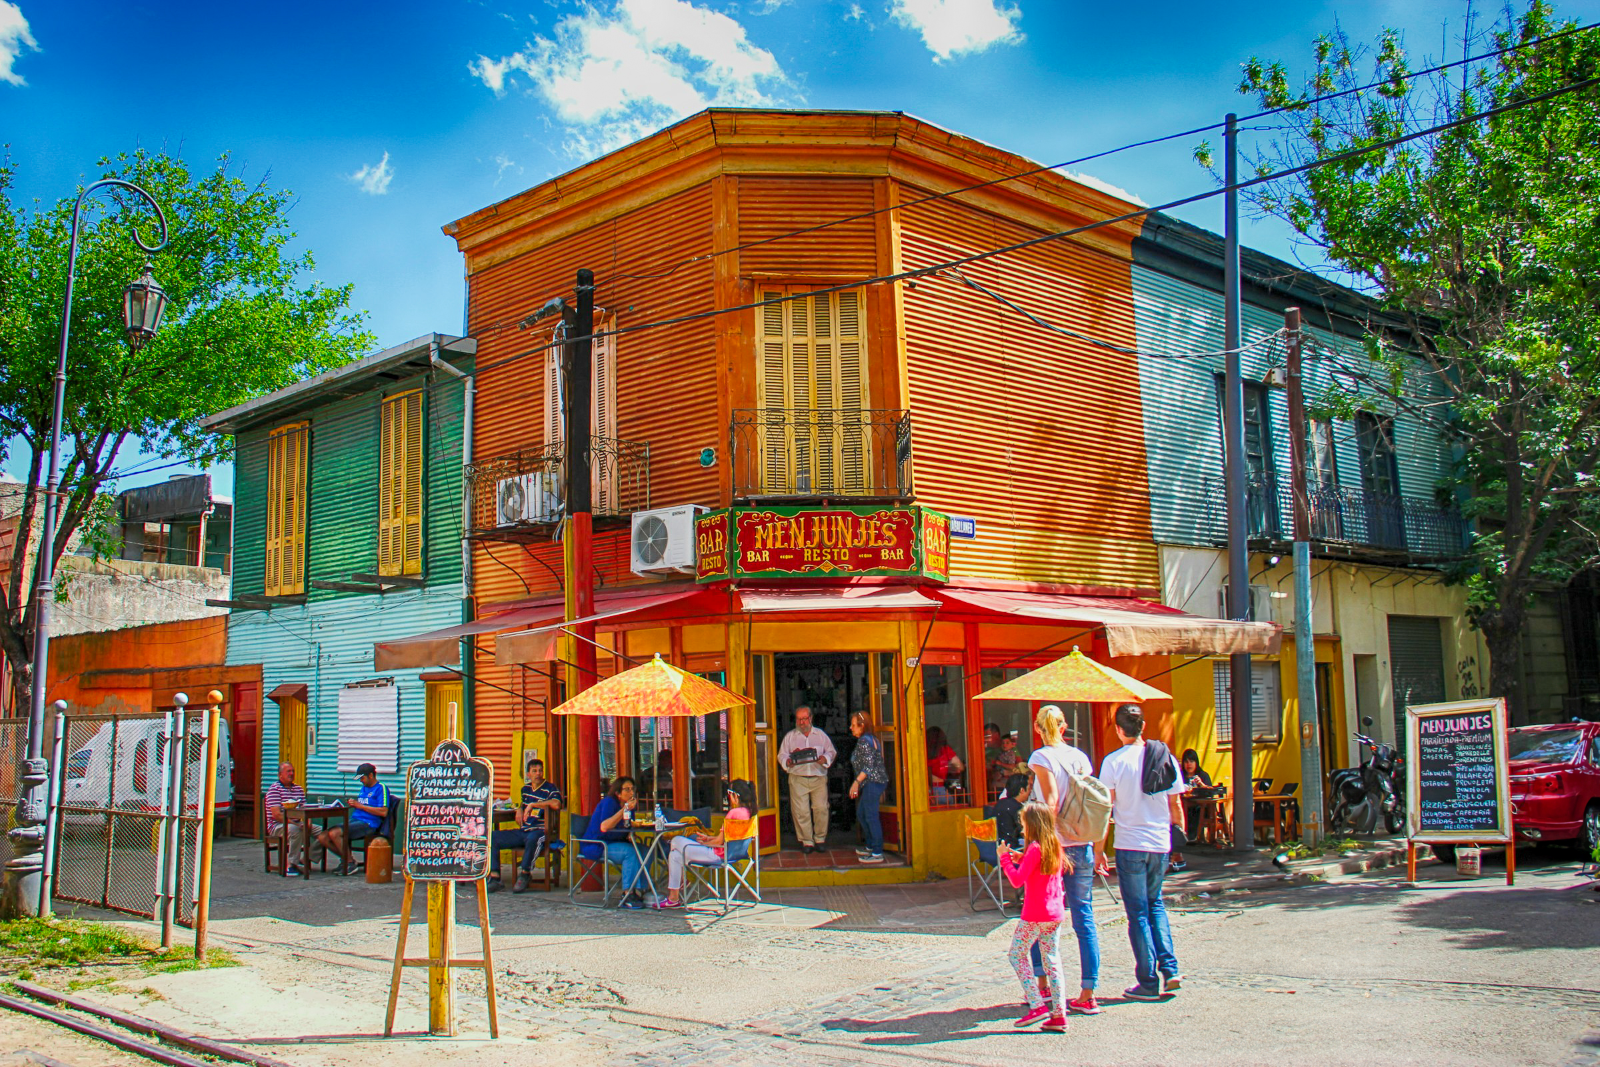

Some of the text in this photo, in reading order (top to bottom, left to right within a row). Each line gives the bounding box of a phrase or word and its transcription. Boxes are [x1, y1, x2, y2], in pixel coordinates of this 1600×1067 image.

[755, 515, 898, 549] MENJUNJES
[699, 529, 724, 555] BAR
[926, 528, 947, 554] BAR
[701, 555, 722, 570] RESTO
[747, 549, 904, 562] BAR RESTO BAR
[928, 553, 945, 569] RESTO
[1420, 715, 1492, 733] MENJUNJES
[433, 749, 461, 762] HOY
[412, 767, 472, 778] PARRILLA
[415, 786, 488, 800] 2 PERSONAS 440
[411, 805, 480, 817] PIZZA GRANDE
[411, 831, 458, 841] TOSTADOS
[410, 849, 446, 859] PASTAS
